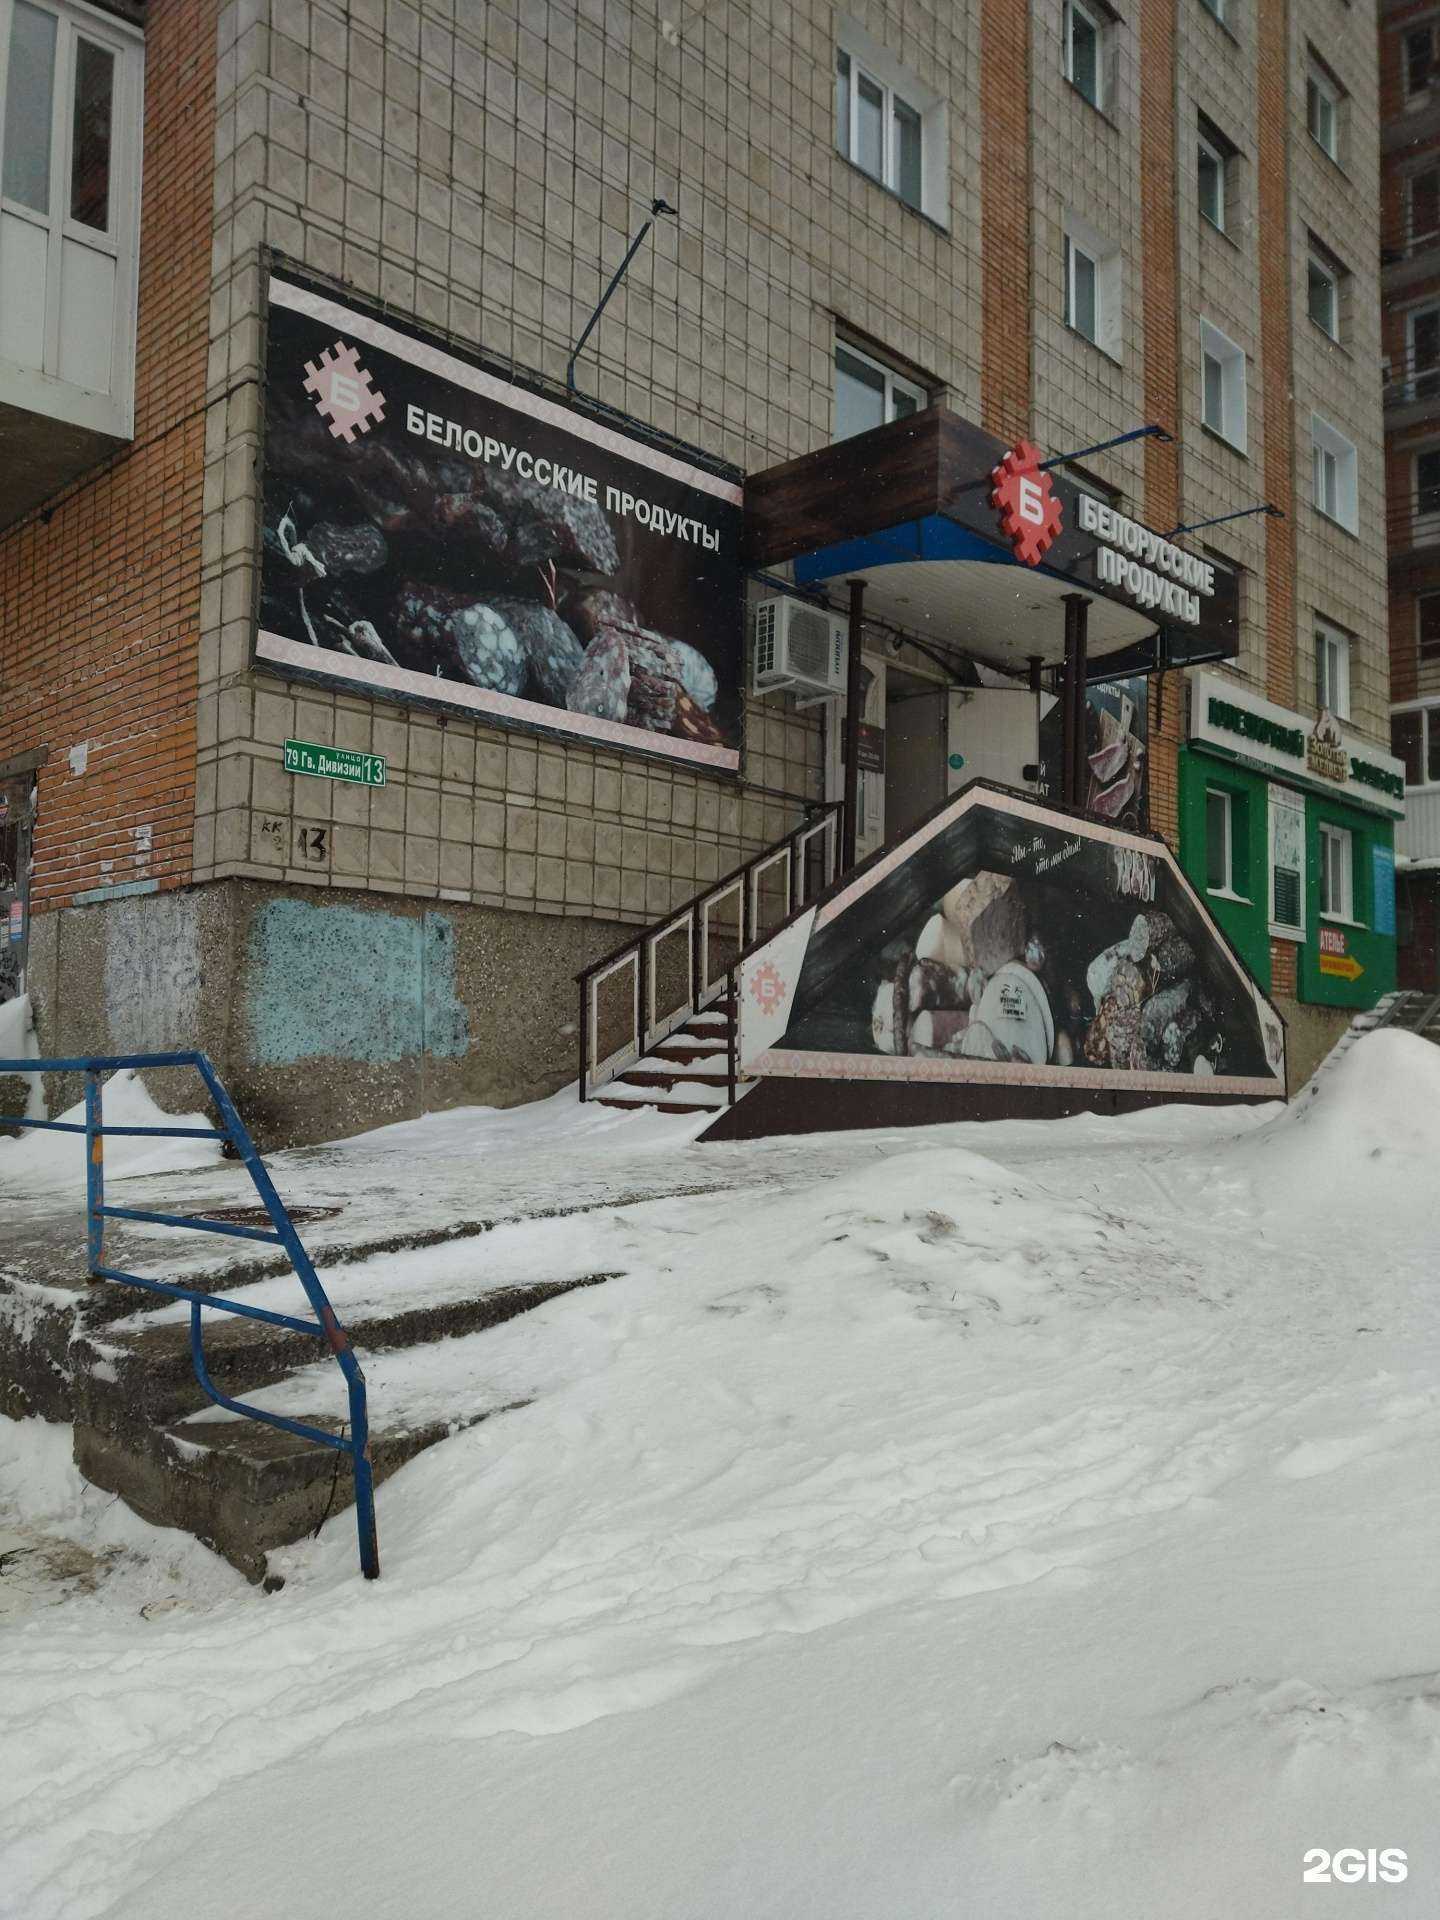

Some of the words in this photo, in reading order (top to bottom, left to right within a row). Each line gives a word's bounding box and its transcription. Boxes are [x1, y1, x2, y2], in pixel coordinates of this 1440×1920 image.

[330, 371, 361, 411] Б
[406, 403, 598, 504] БЕЛОРУССКИЕ
[606, 485, 720, 553] ПРОДУКТЫ
[1020, 476, 1044, 525] Б
[1079, 494, 1215, 597] БЕЛОРУССКИЕ
[1097, 546, 1200, 625] ПРОДУКТЫ
[286, 748, 299, 766] 79
[301, 751, 316, 769] Гв.
[318, 755, 361, 778] Дивизии
[364, 758, 383, 783] 13
[336, 752, 361, 763] улица
[298, 828, 328, 862] 13
